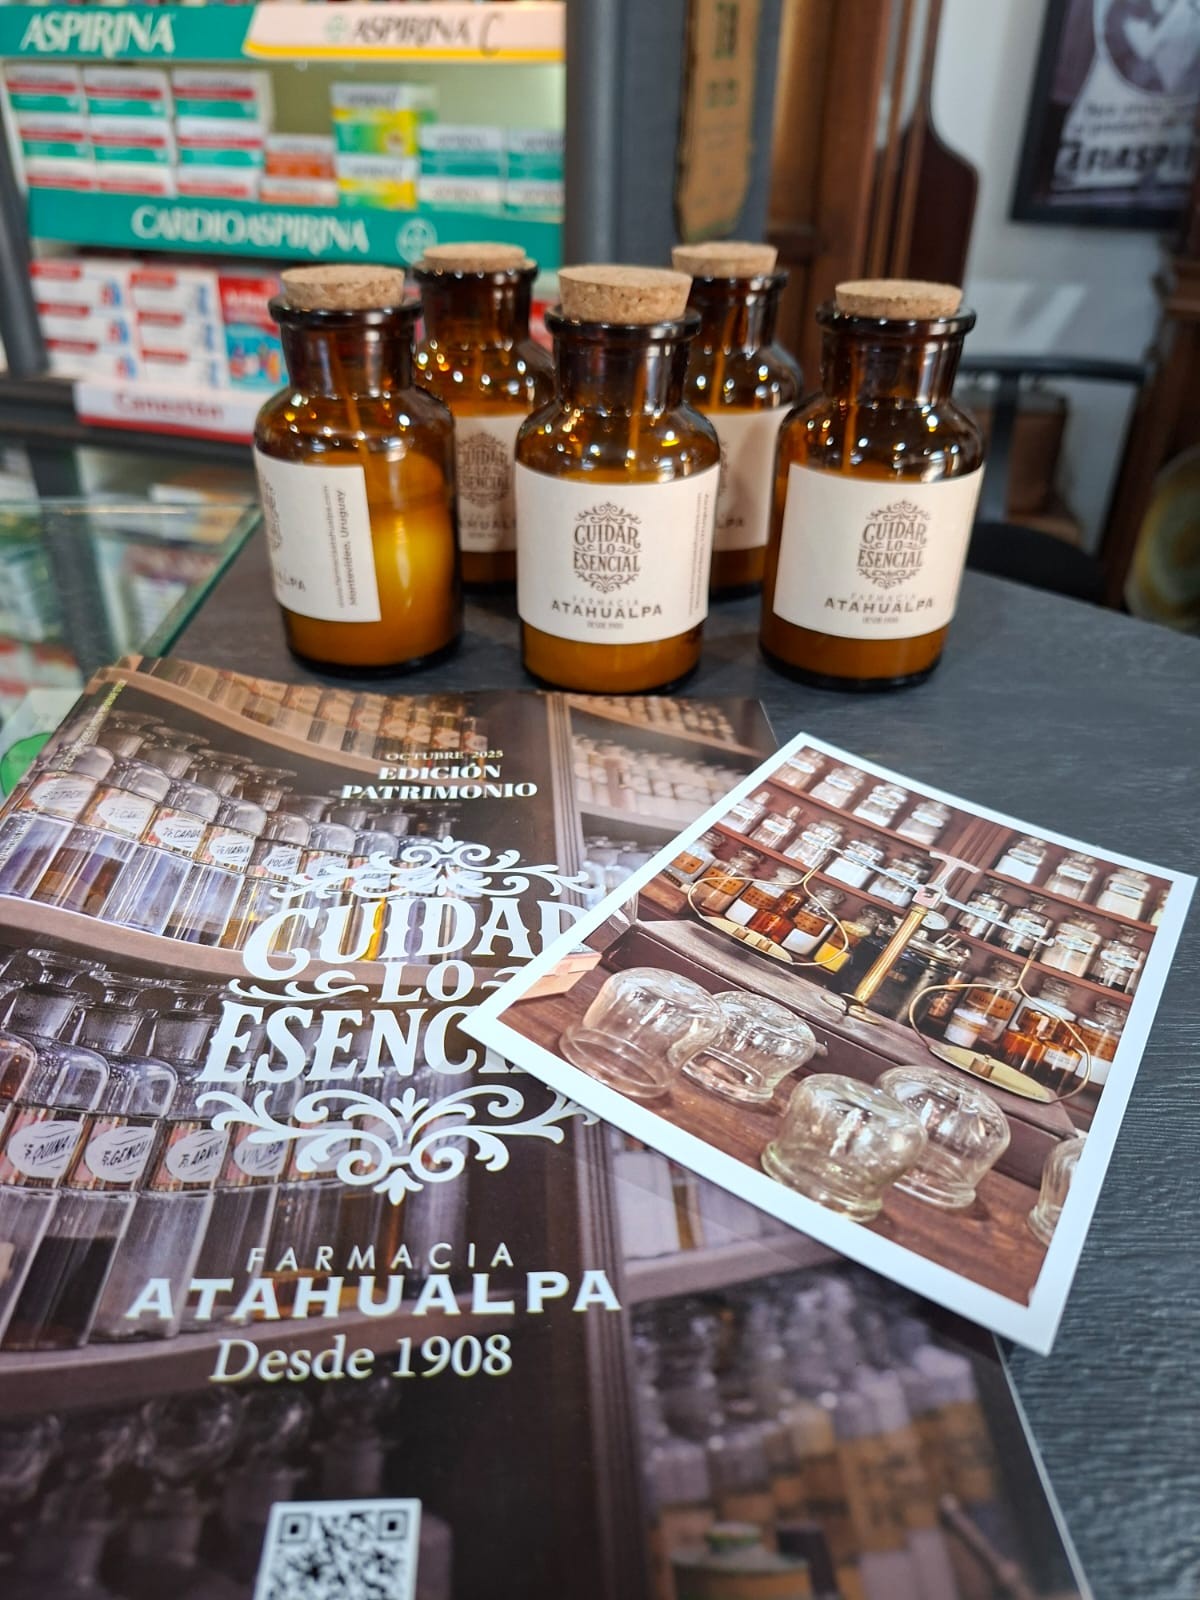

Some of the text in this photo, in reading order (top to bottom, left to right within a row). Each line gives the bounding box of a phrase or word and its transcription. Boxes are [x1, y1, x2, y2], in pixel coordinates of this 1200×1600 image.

[19, 11, 176, 58] ASPIRINA
[353, 13, 473, 48] ASPIRINA
[131, 205, 369, 254] CARDIOASPIRINA
[336, 489, 349, 538] Uruguay
[574, 524, 641, 549] CUIDAR
[862, 522, 928, 545] CUIDAR
[599, 543, 616, 556] LO
[886, 541, 904, 551] LO
[573, 550, 641, 572] ESENCIAL
[857, 550, 924, 569] ESENCIAL
[552, 600, 663, 619] ATAHUALPA
[824, 597, 934, 615] ATAHUALPA
[385, 750, 504, 761] OCTUBRE 2025
[378, 762, 502, 780] EDICIÓN
[341, 782, 539, 800] PATRIMONIO
[378, 959, 476, 1003] LO
[195, 1000, 527, 1083] ESENC
[246, 1243, 515, 1273] FARMACIA
[125, 1269, 623, 1320] ATAHUALPA
[210, 1333, 513, 1384] Desde 1908
